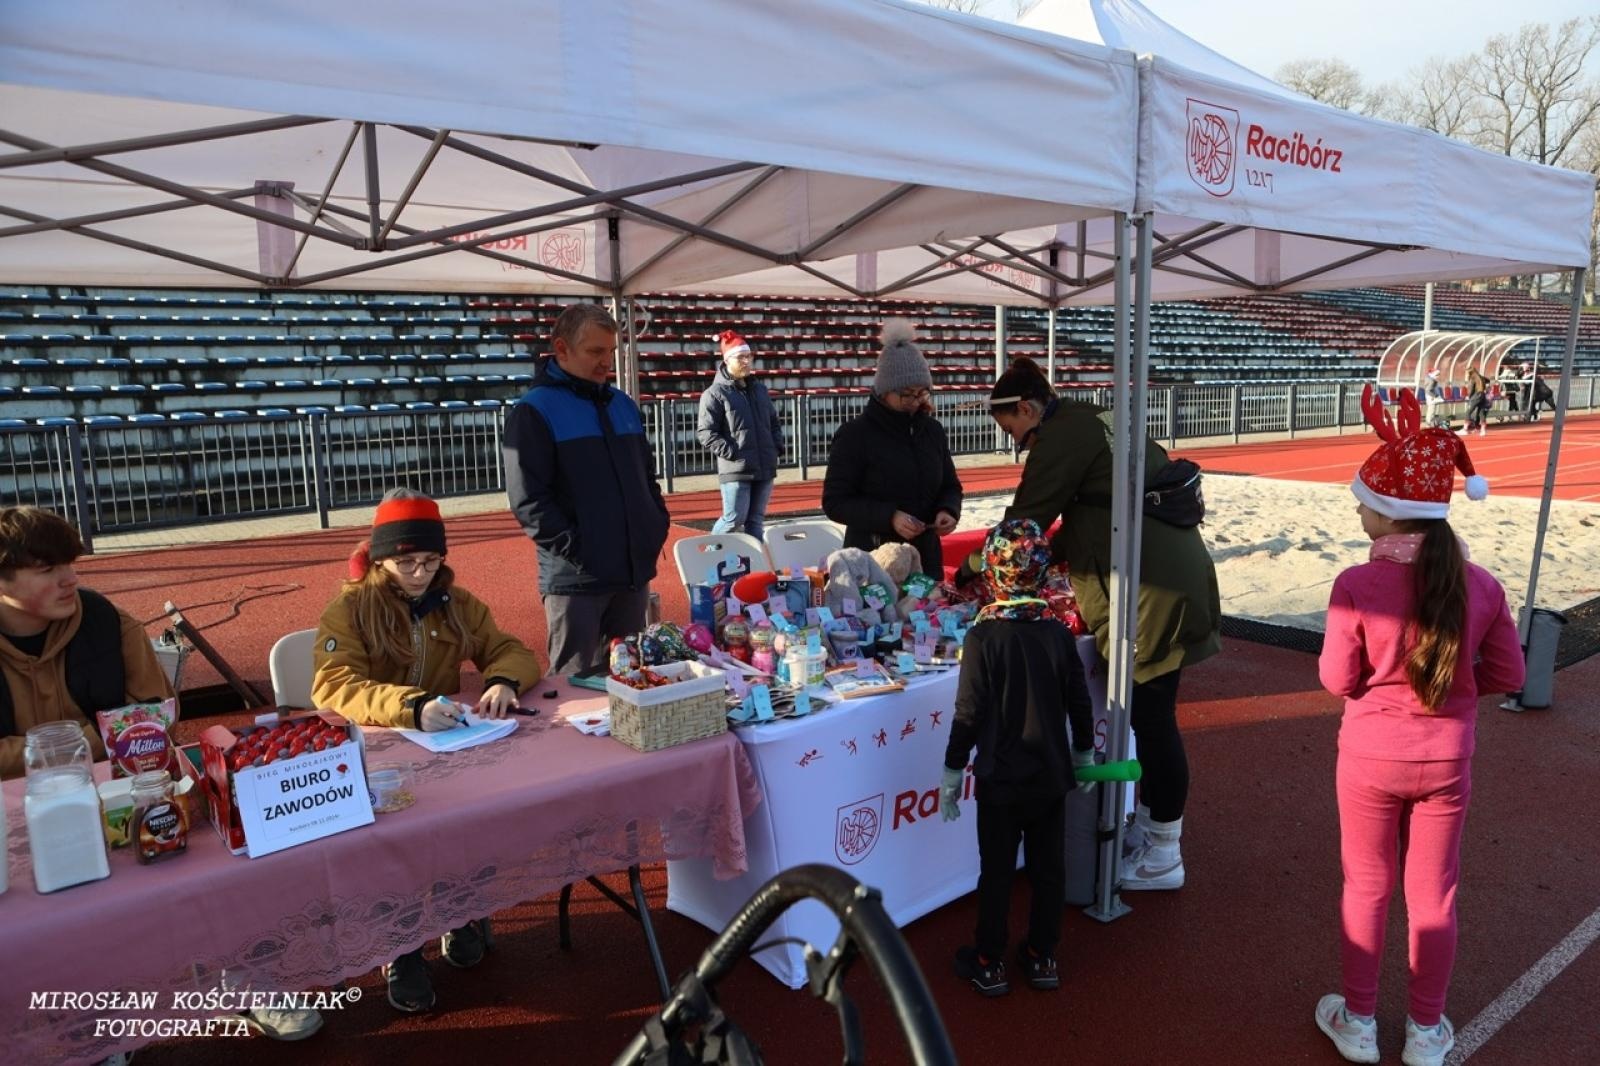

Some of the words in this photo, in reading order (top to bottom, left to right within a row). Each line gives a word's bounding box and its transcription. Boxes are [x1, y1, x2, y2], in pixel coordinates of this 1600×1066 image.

[1246, 124, 1343, 173] Racibórz
[1245, 168, 1274, 194] 1217
[257, 769, 279, 780] BIEG
[280, 769, 331, 793] BIURO
[263, 784, 354, 821] ZAWODÓW
